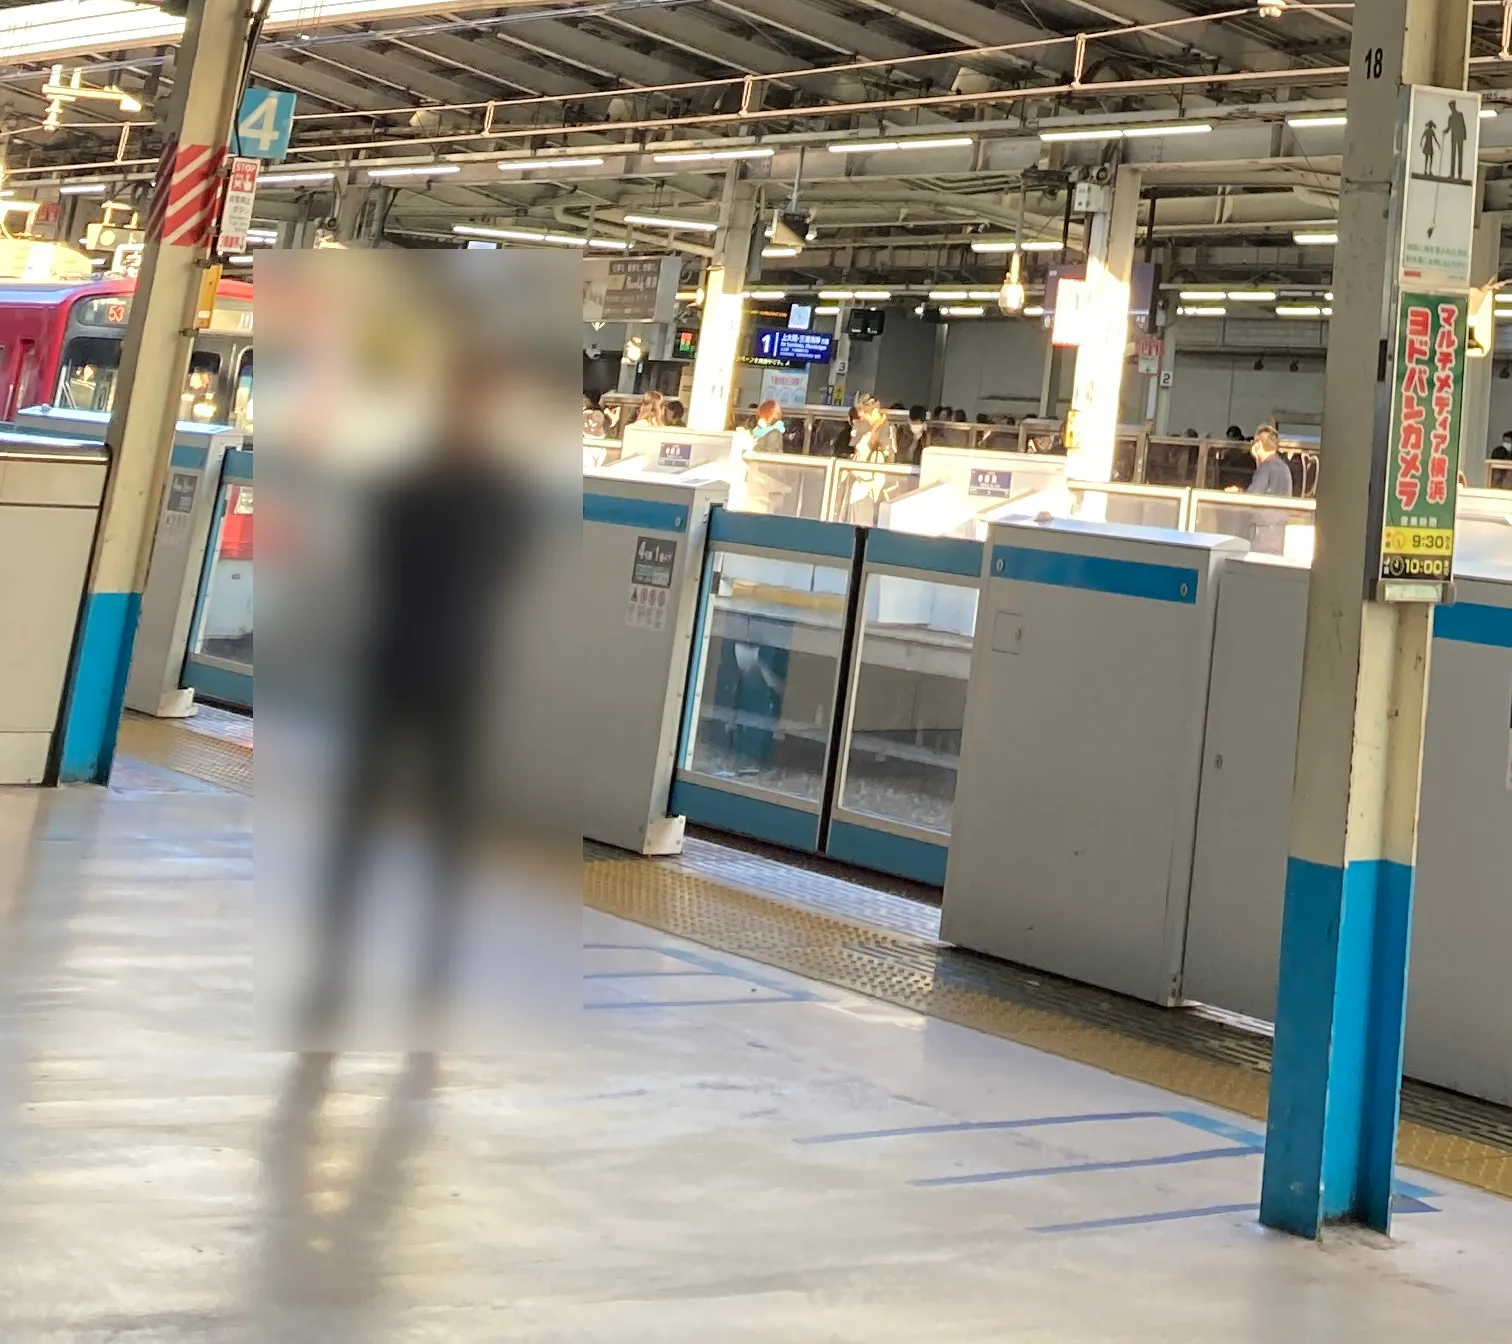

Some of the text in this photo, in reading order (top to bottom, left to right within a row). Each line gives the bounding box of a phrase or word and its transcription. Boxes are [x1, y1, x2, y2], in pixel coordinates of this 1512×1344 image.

[1364, 47, 1384, 79] 18
[238, 96, 280, 151] 4
[236, 163, 256, 172] STOP
[761, 334, 771, 353] 1
[839, 363, 846, 372] 3
[1162, 373, 1171, 384] 2
[1412, 535, 1444, 549] 9:30
[1405, 558, 1442, 574] 10:00
